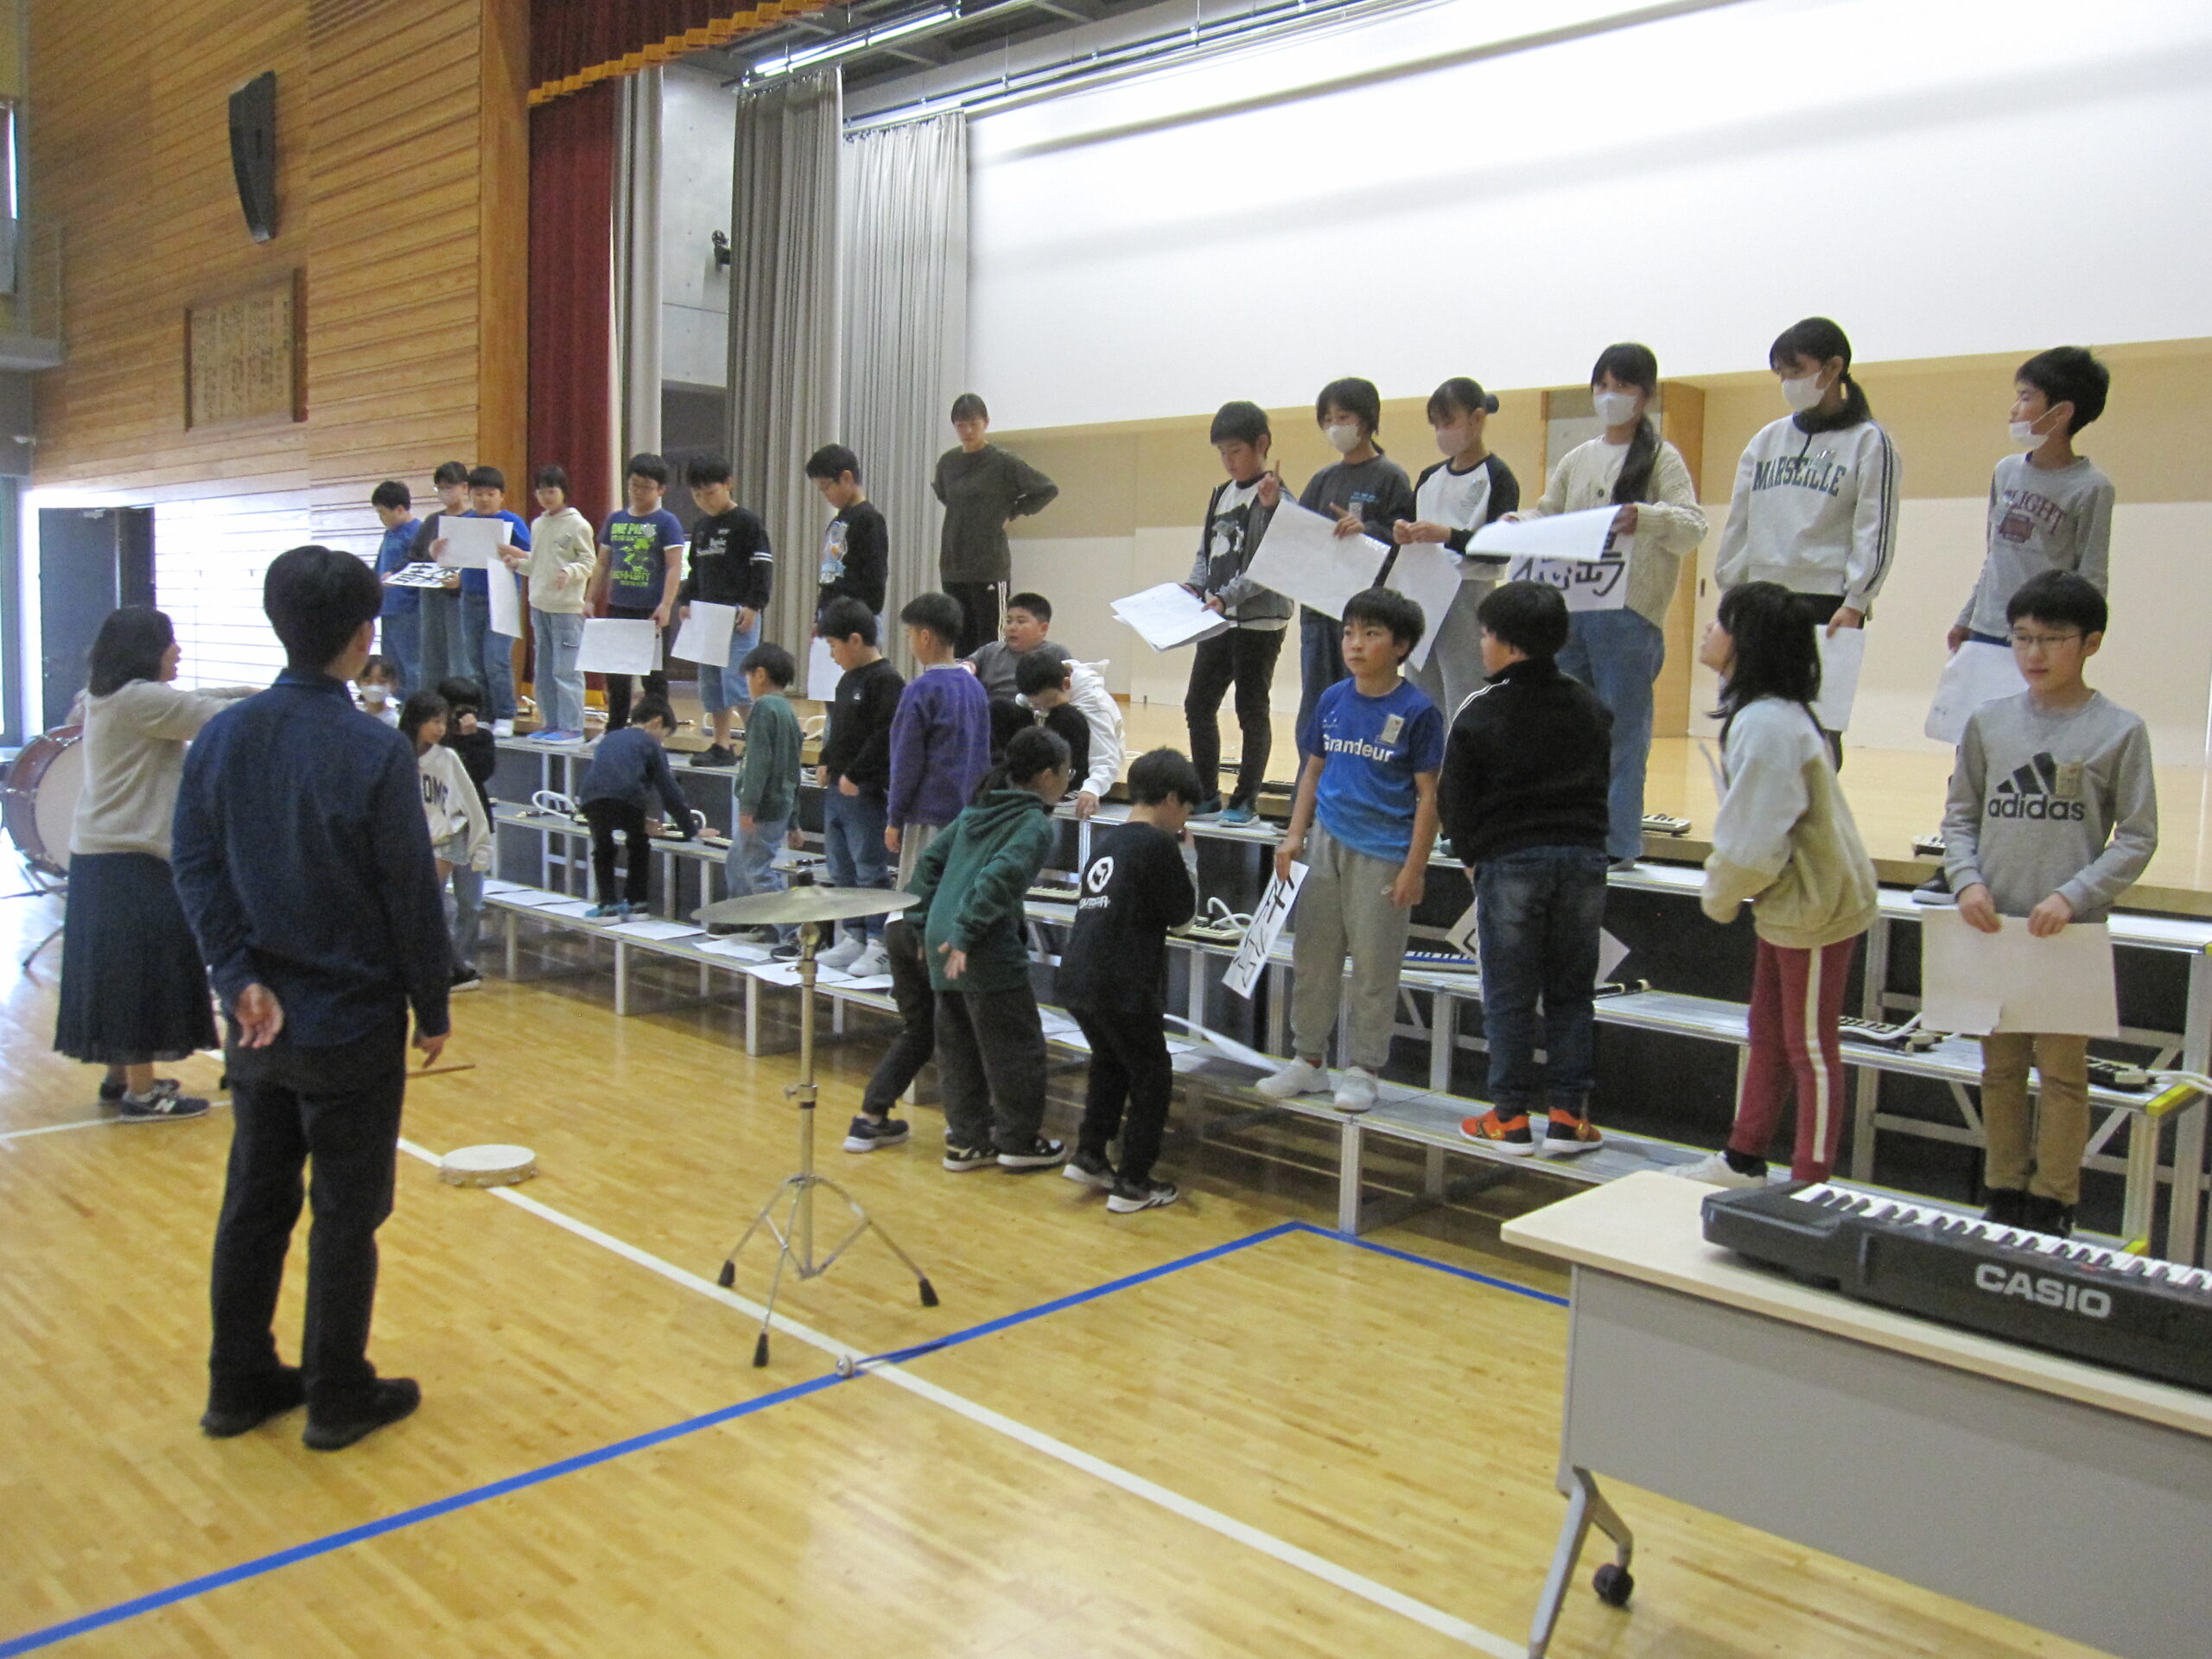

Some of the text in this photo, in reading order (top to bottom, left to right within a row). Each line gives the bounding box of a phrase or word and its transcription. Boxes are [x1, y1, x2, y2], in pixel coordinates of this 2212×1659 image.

[1751, 455, 1847, 497] MARSEILLE
[1988, 792, 2085, 822] adidas
[1974, 1262, 2112, 1319] CASIO
